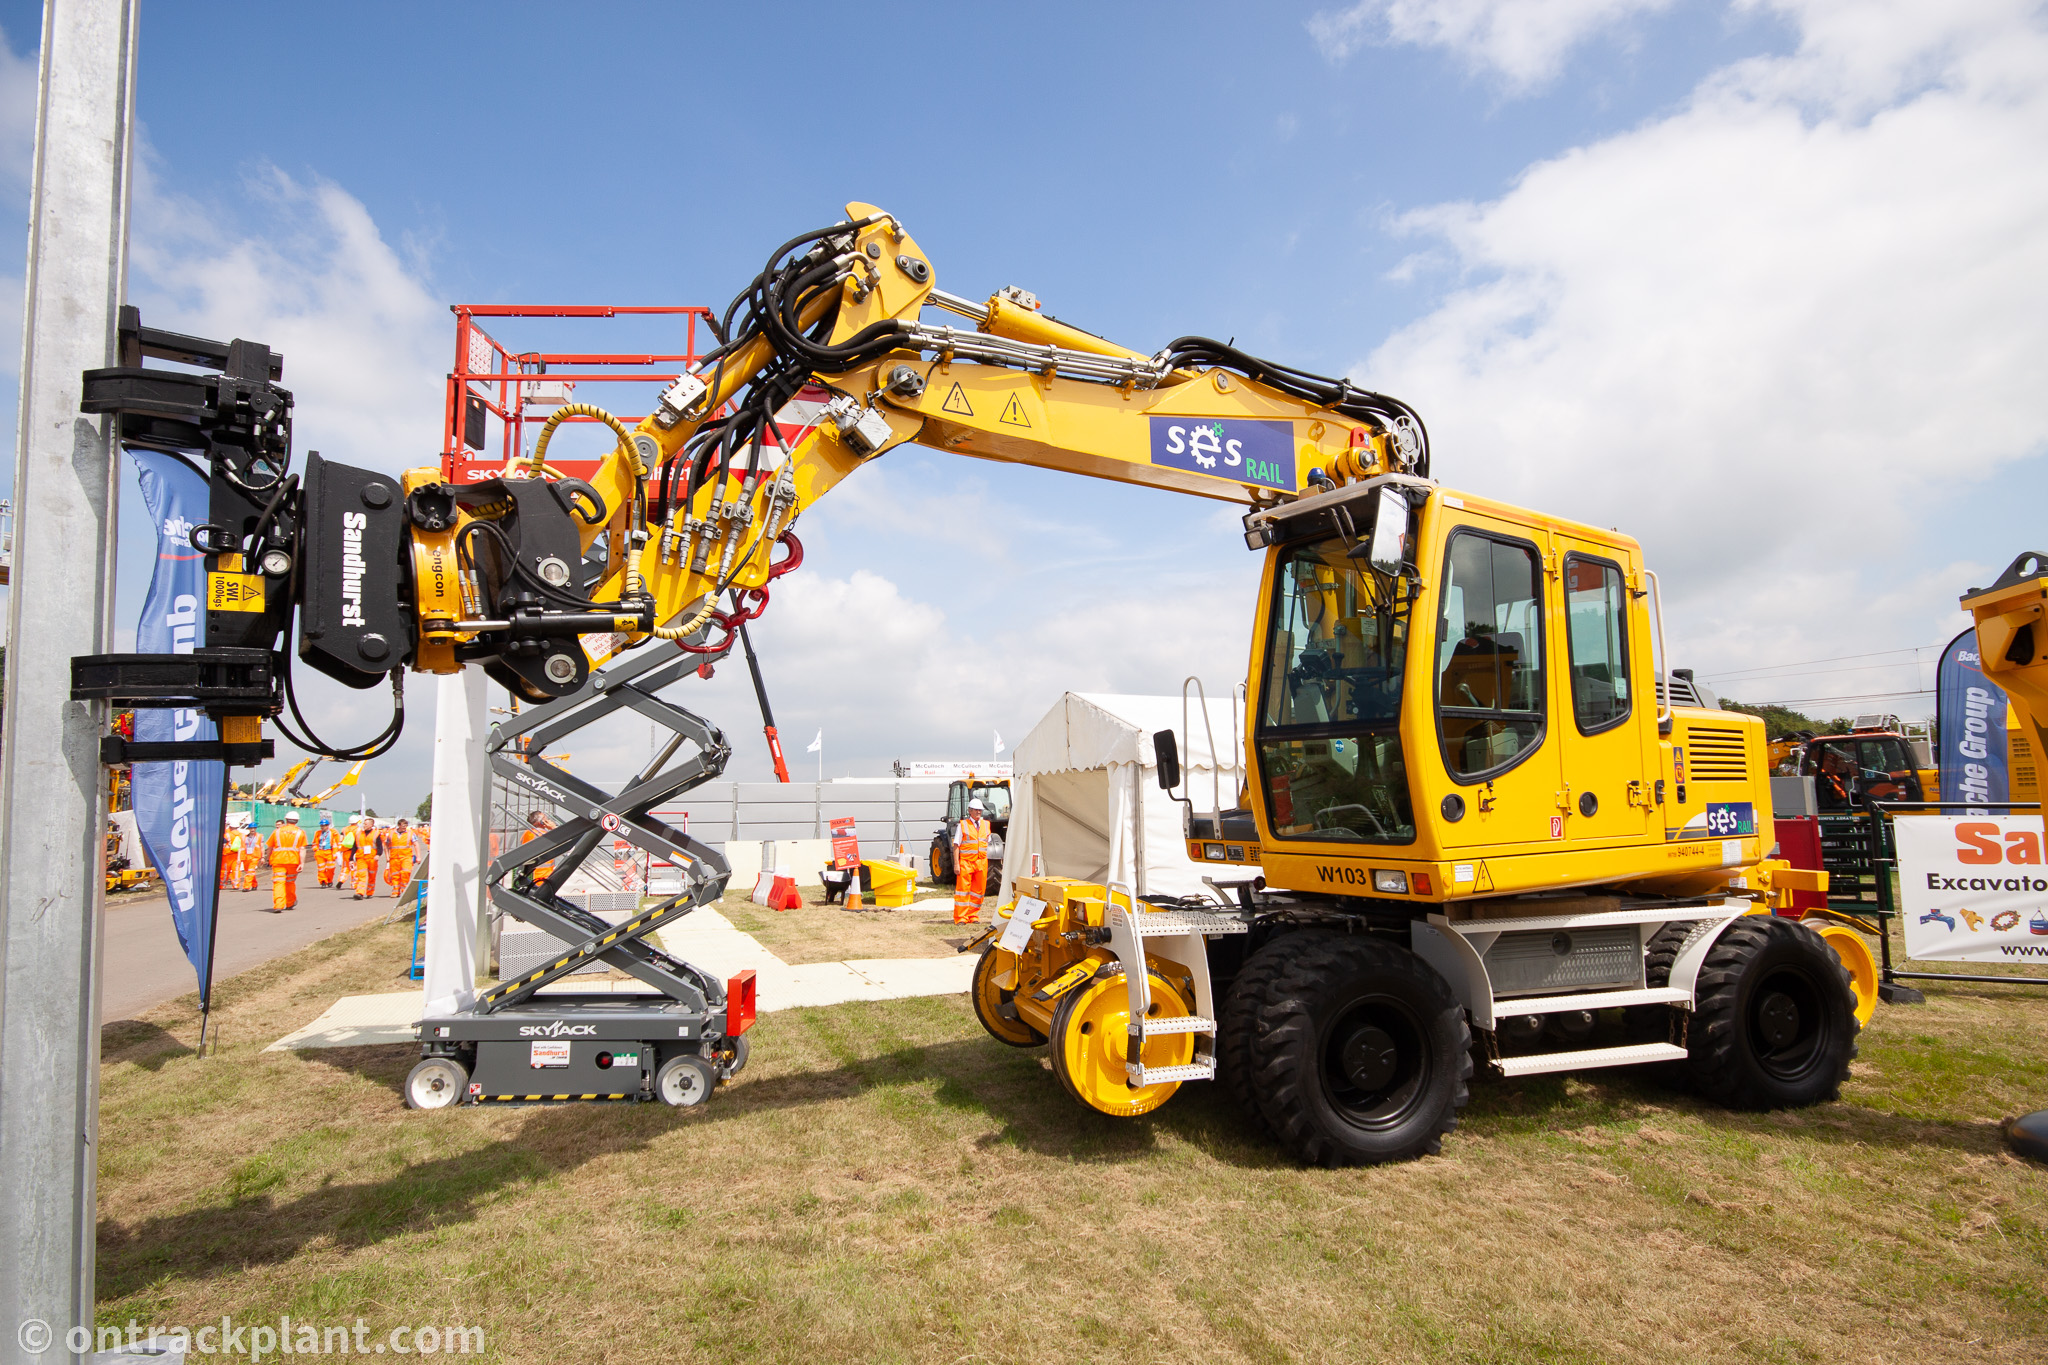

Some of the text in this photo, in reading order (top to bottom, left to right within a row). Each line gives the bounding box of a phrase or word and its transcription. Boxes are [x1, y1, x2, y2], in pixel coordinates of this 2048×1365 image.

[1246, 457, 1284, 484] RAIL
[342, 511, 367, 628] Sandhurst
[432, 549, 445, 598] engcon
[213, 576, 225, 607] 1000kgs
[226, 581, 239, 602] SWL
[1959, 686, 1995, 759] Group
[515, 772, 567, 803] SKYJACK
[1737, 820, 1753, 833] RAIL
[1677, 846, 1704, 857] 940744-4
[1316, 865, 1367, 885] W103
[1927, 873, 2048, 892] Excavato
[519, 1021, 597, 1037] SKYJACK
